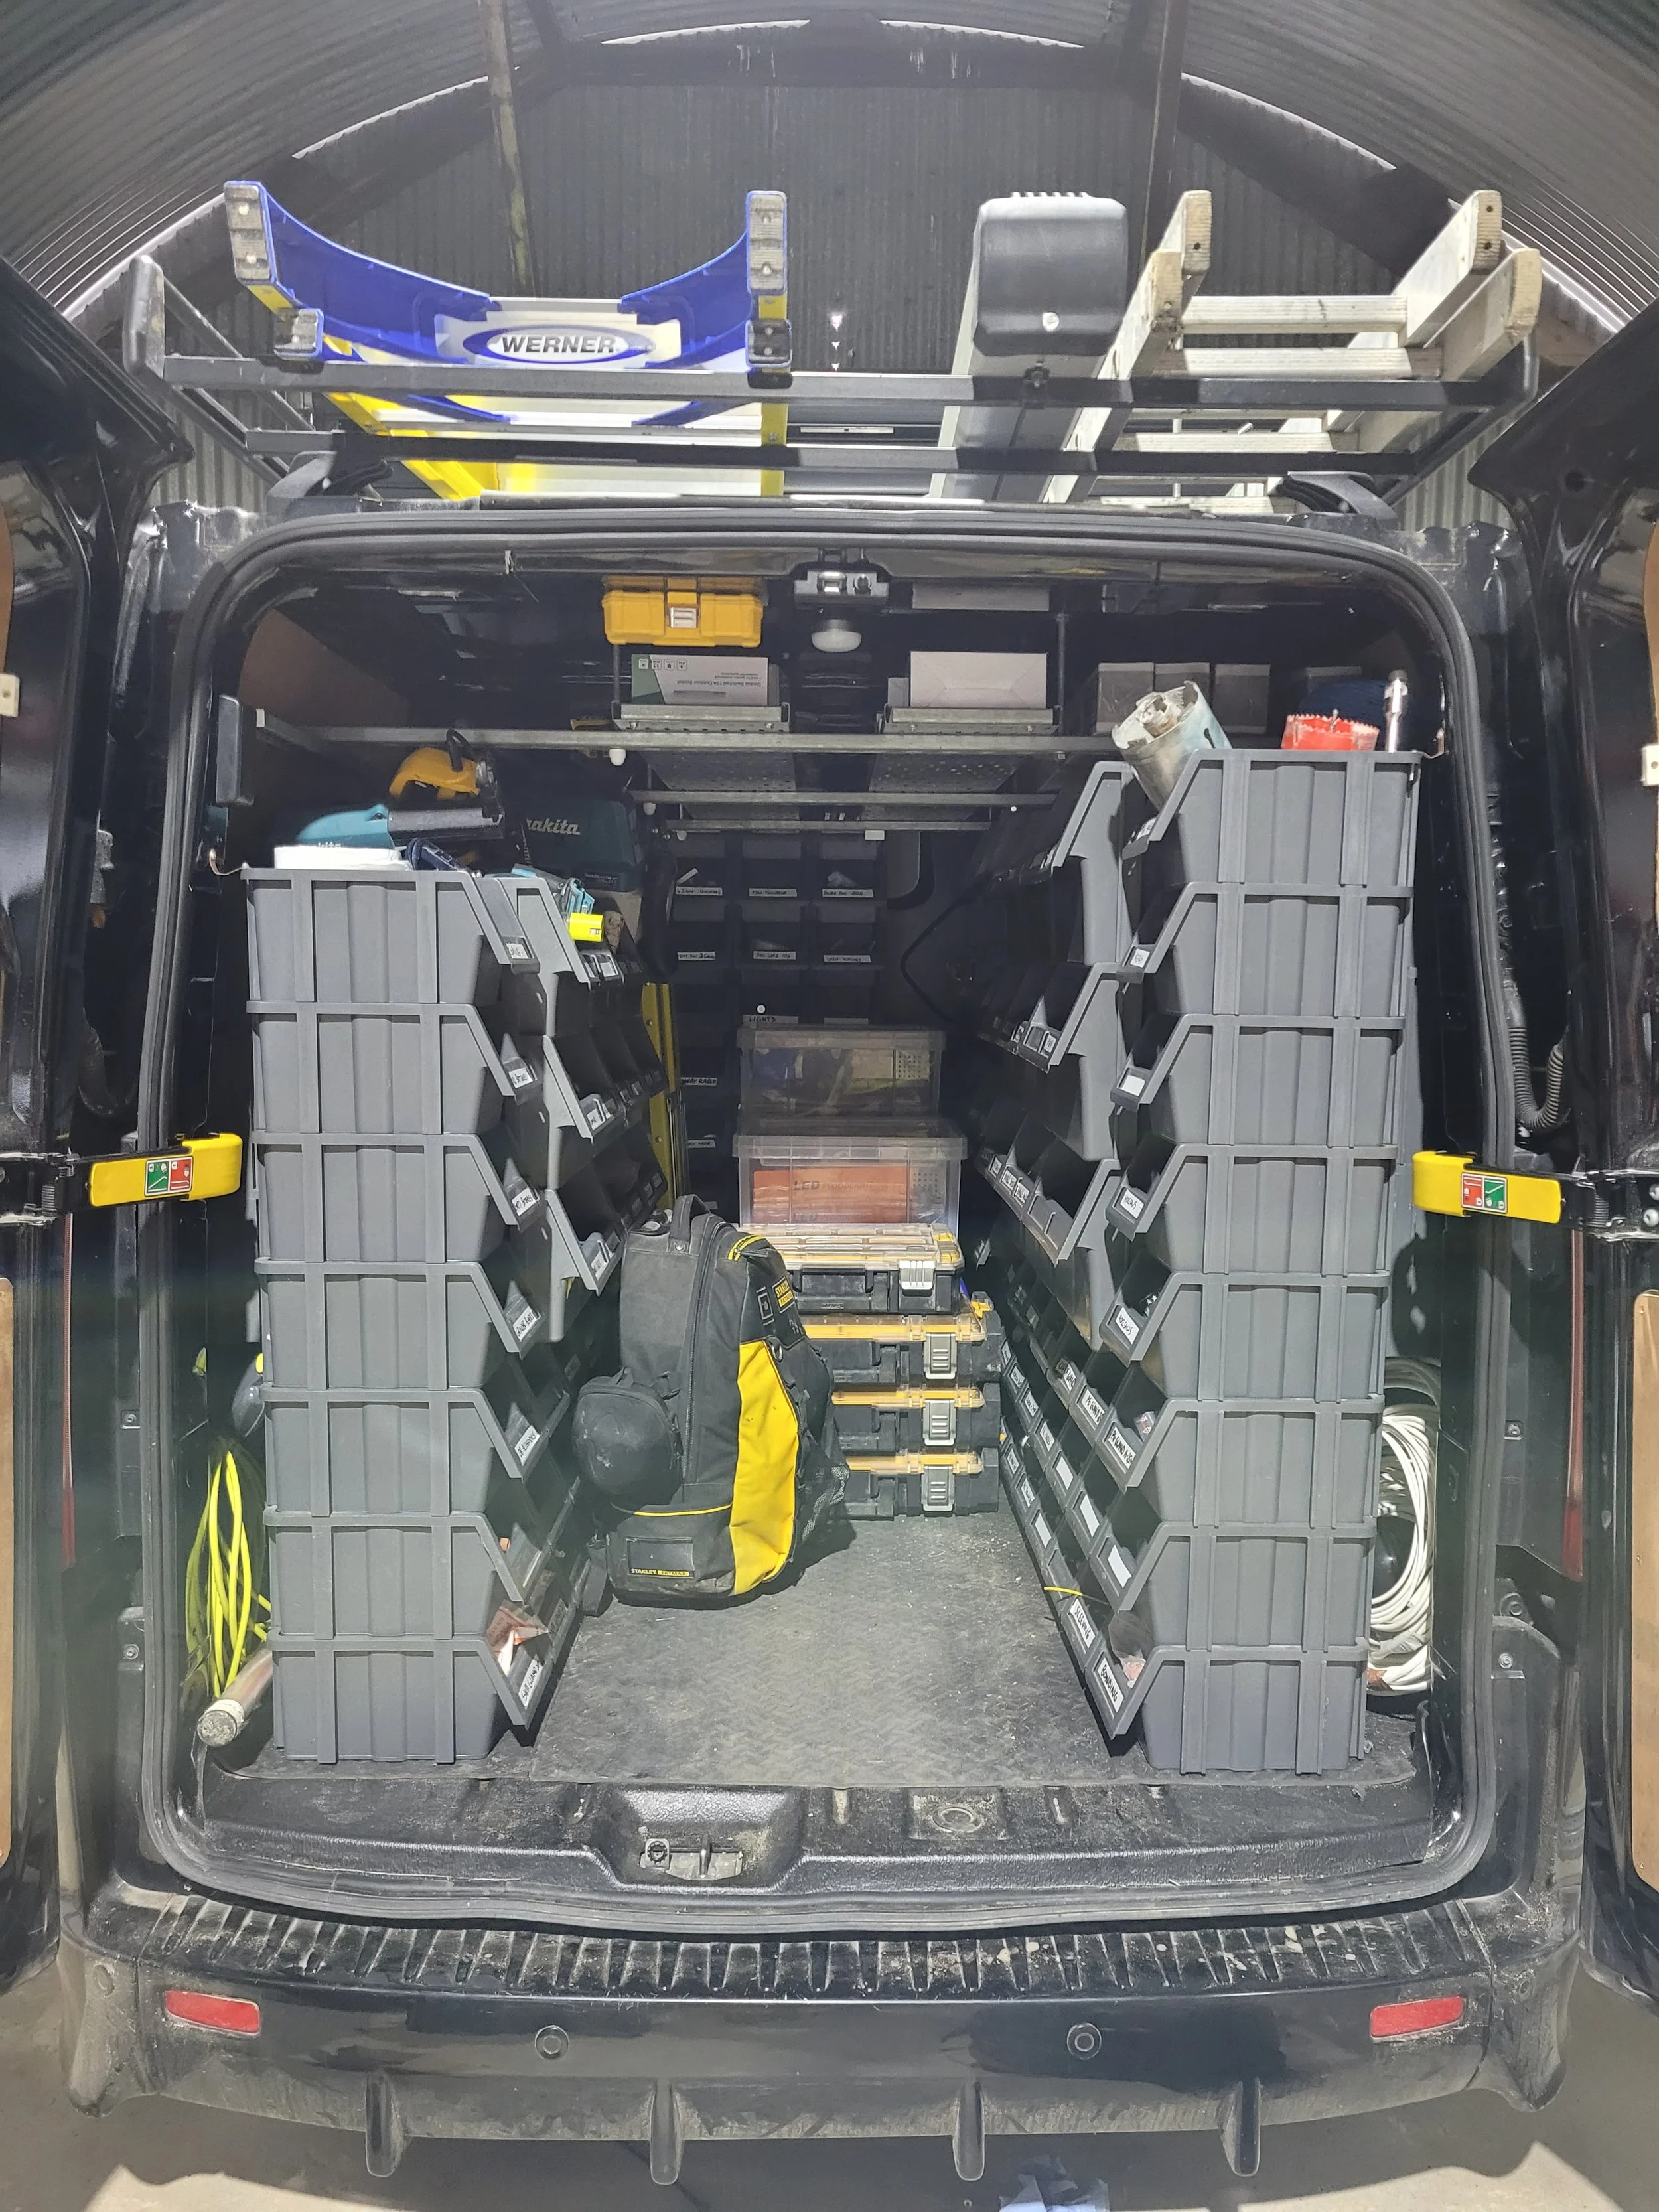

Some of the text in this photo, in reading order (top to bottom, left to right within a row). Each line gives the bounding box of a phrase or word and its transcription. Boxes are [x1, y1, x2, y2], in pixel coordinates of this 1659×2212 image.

[502, 335, 616, 354] WERNER
[793, 1181, 820, 1190] LED
[1074, 1606, 1092, 1640] SLEEVING
[1100, 1664, 1119, 1703] BONDING
